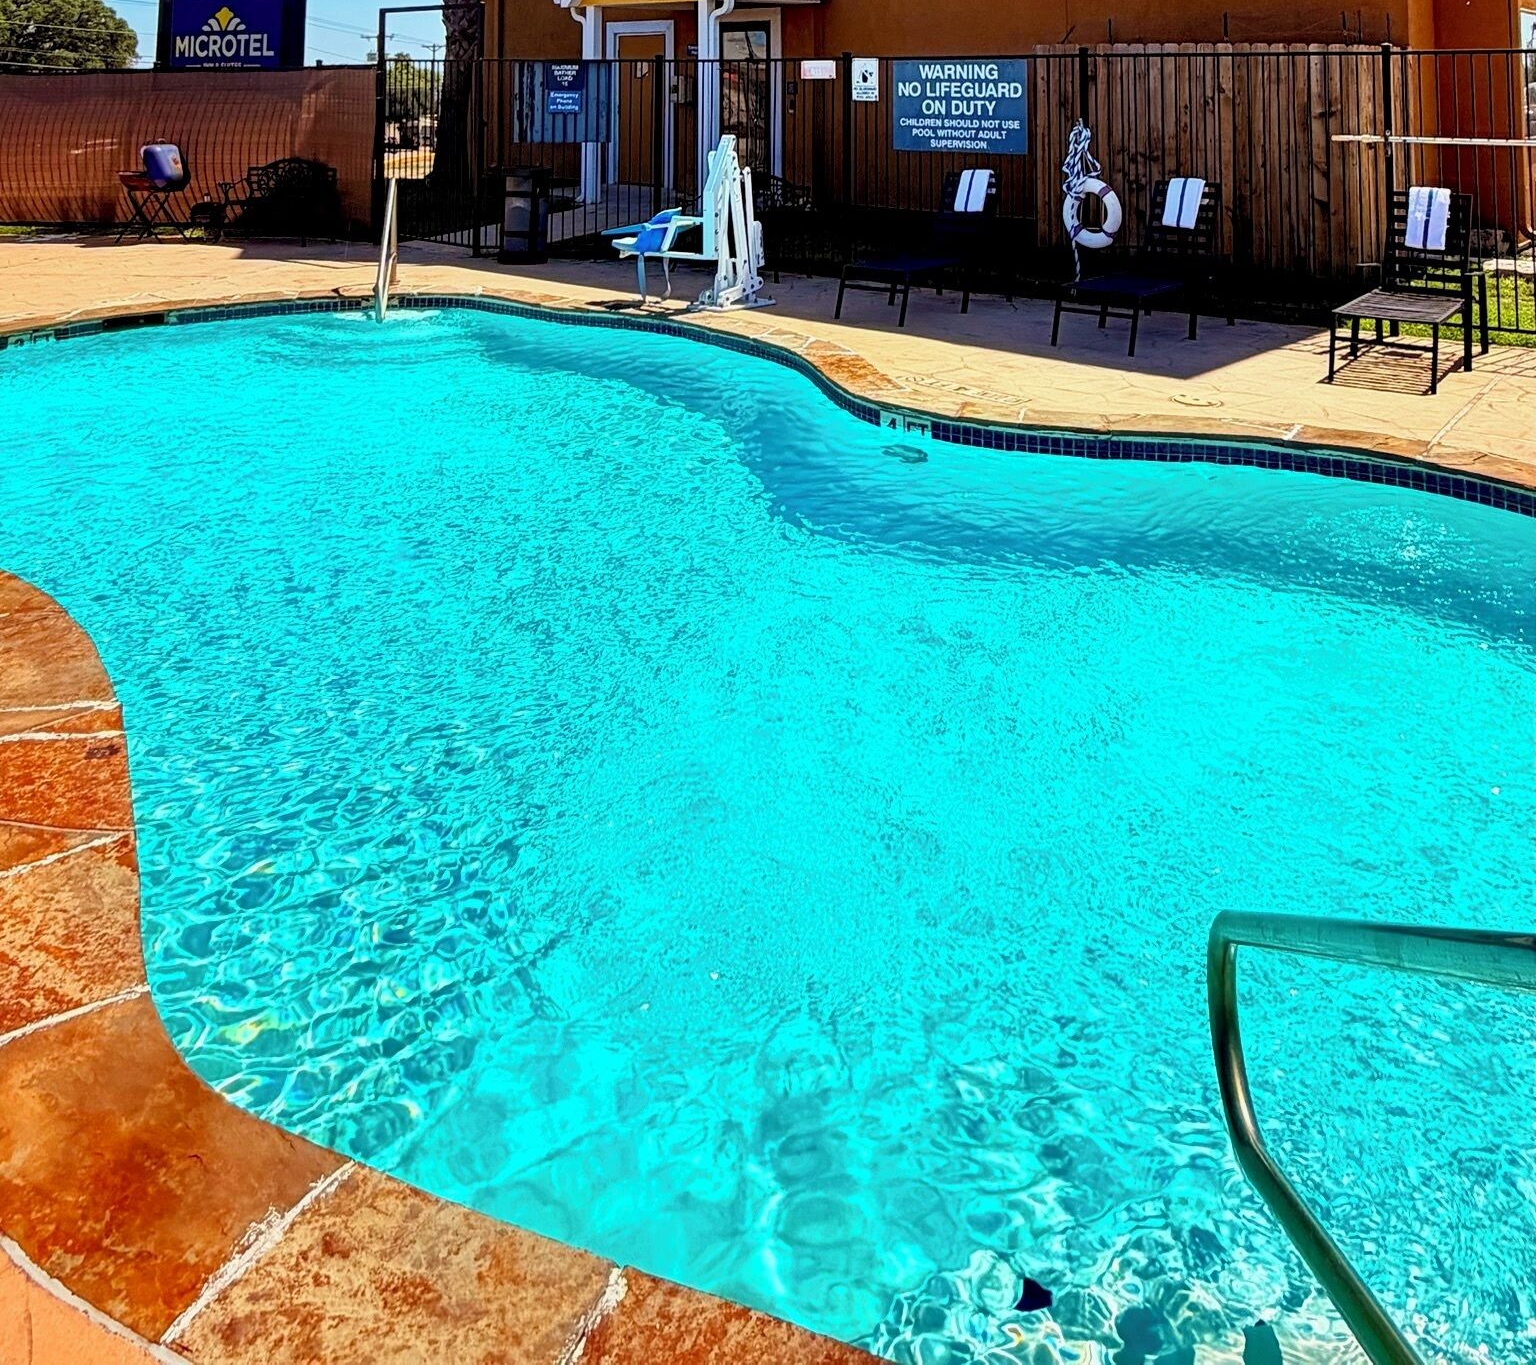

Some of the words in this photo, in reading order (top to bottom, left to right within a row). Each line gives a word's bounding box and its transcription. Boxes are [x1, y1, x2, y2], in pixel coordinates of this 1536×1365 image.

[175, 33, 275, 58] MICROTEL
[919, 64, 998, 80] WARNING
[898, 81, 921, 97] NO
[926, 81, 1022, 98] LIFEGUARD
[922, 99, 946, 115] ON
[951, 100, 996, 116] DUTY
[900, 118, 942, 127] CHILDREN
[943, 118, 979, 128] SHOULD
[981, 119, 1000, 129] NOT
[1001, 120, 1020, 129] USE
[912, 128, 935, 137] POOL
[936, 129, 976, 138] WITHOUT
[977, 130, 1007, 140] ADULT
[930, 138, 987, 149] SUPERVISION
